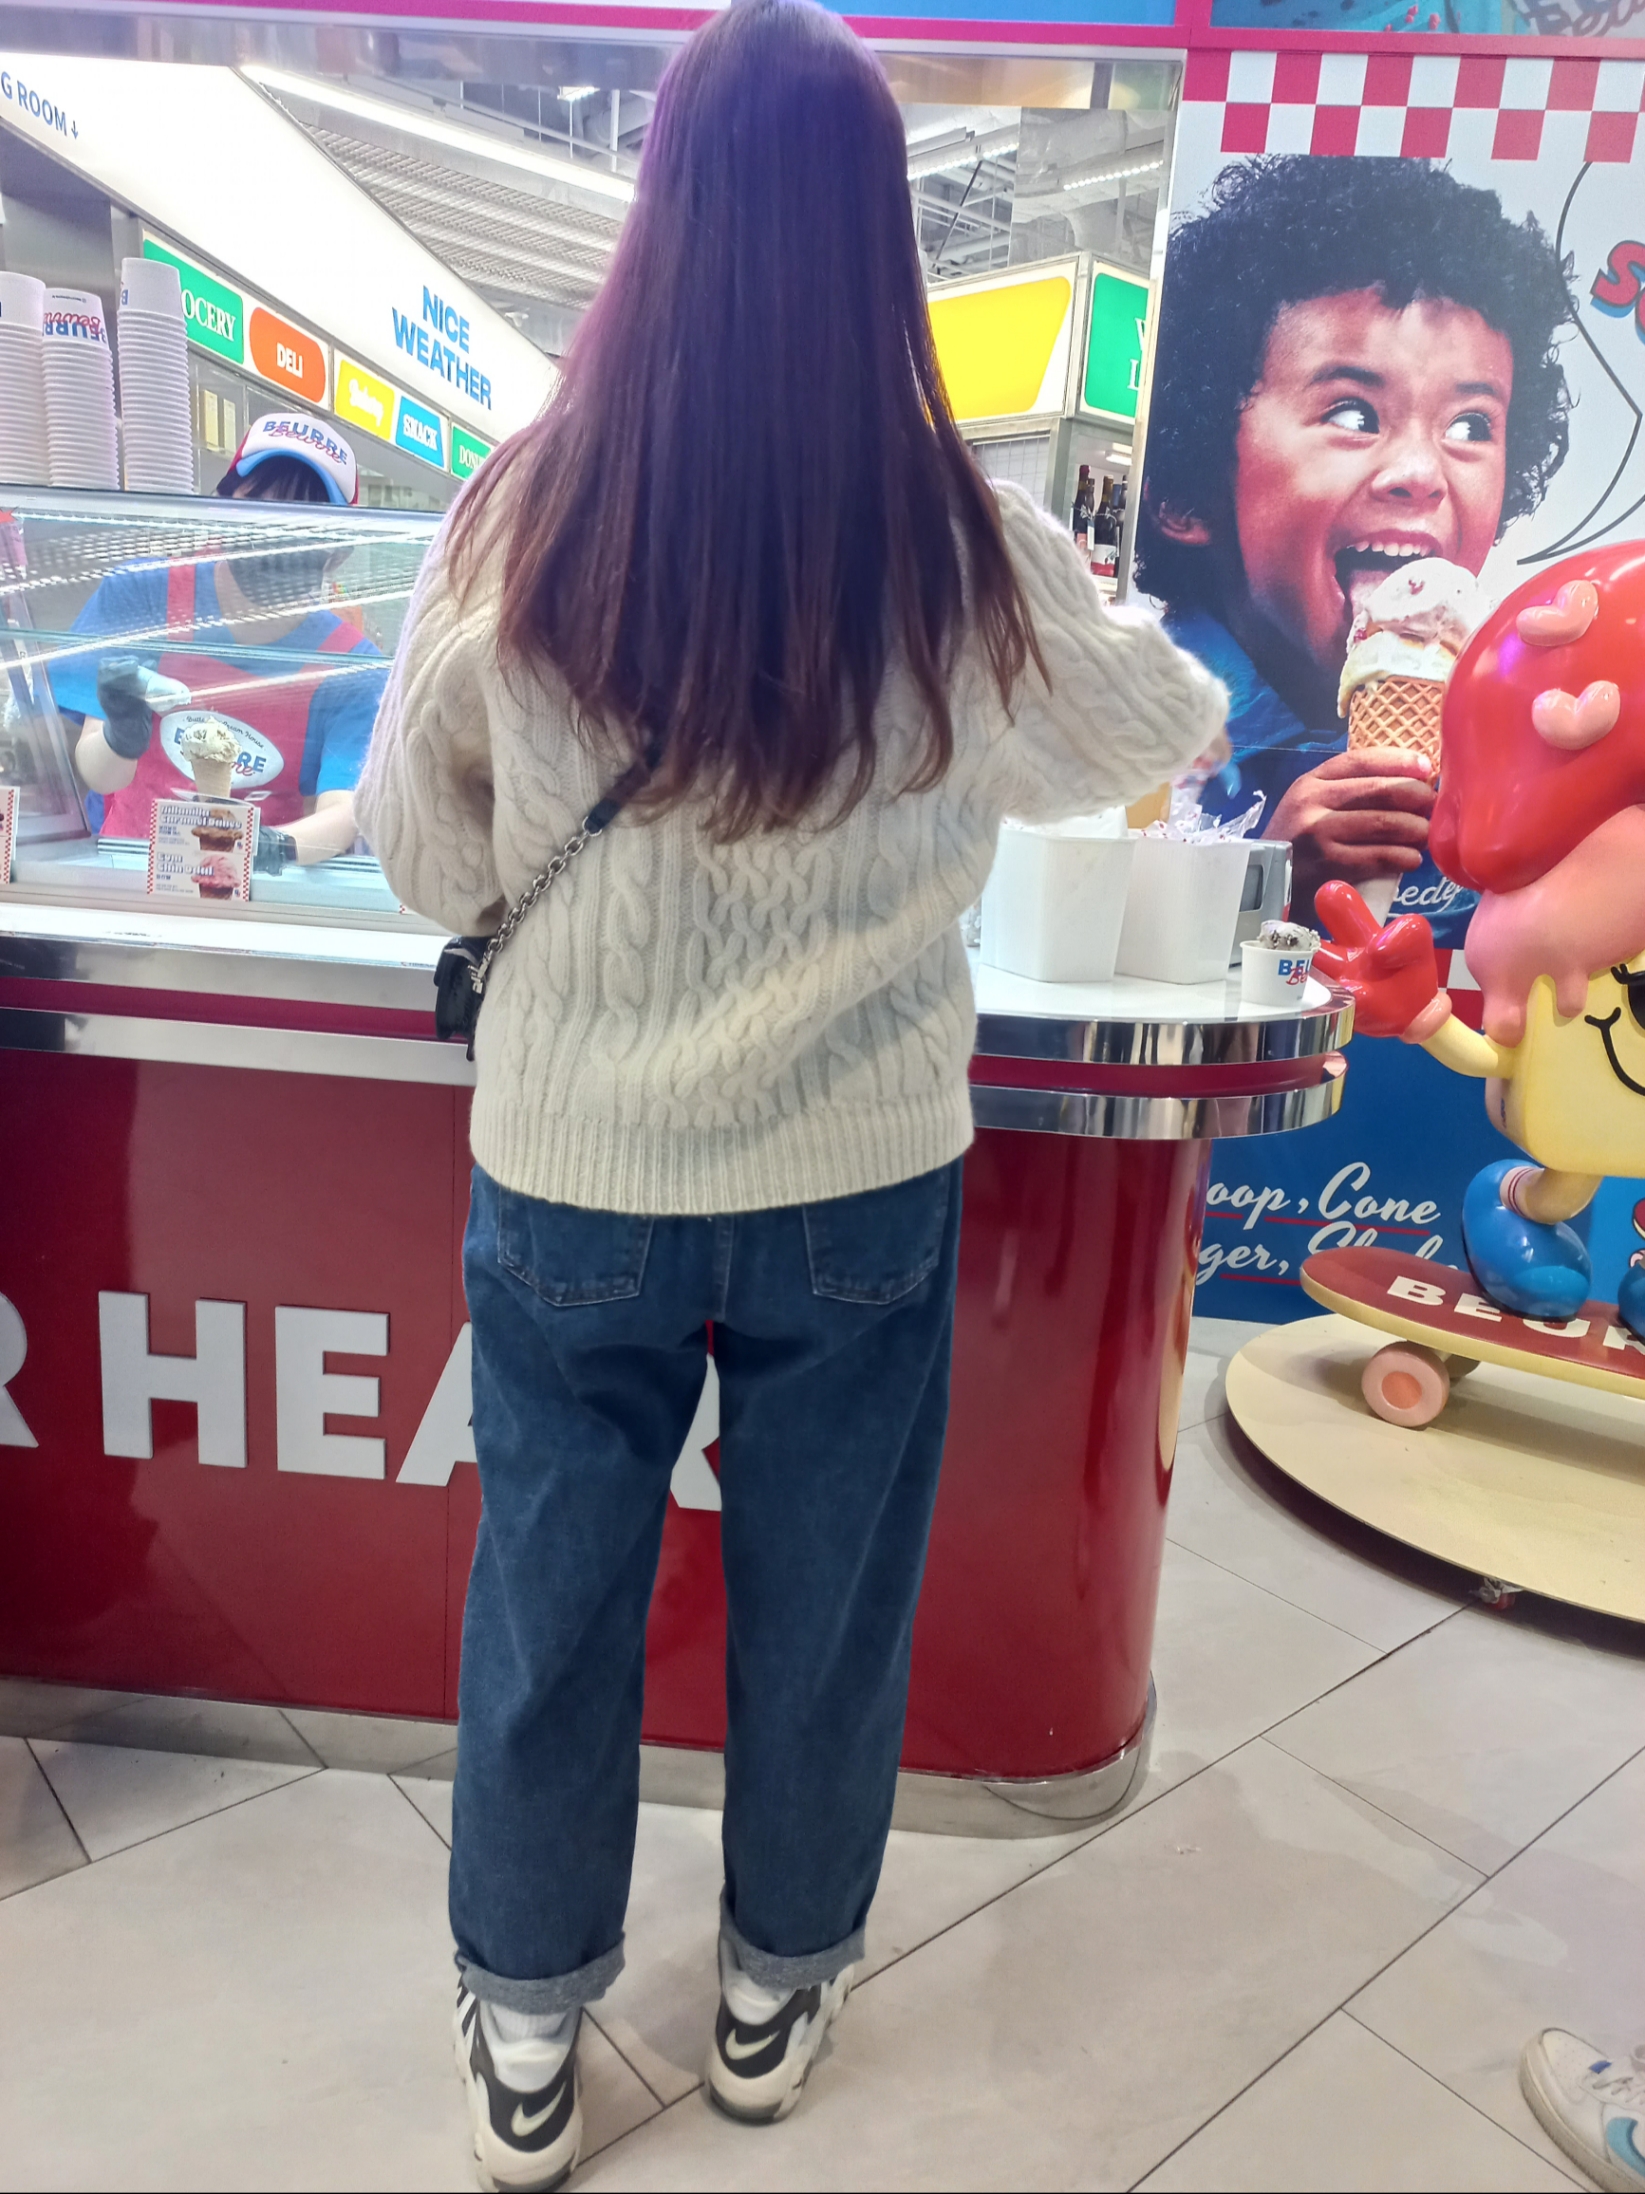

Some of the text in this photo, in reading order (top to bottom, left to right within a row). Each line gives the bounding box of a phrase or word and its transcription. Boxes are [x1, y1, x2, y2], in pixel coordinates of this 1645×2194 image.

[17, 80, 68, 137] ROOM
[181, 288, 237, 342] OCERY
[422, 284, 470, 354] NICE
[276, 341, 304, 379] DELI
[392, 306, 492, 411] WEATHER
[262, 420, 349, 466] BEURRE
[403, 413, 438, 452] SNACK
[1318, 1161, 1442, 1225] Cone
